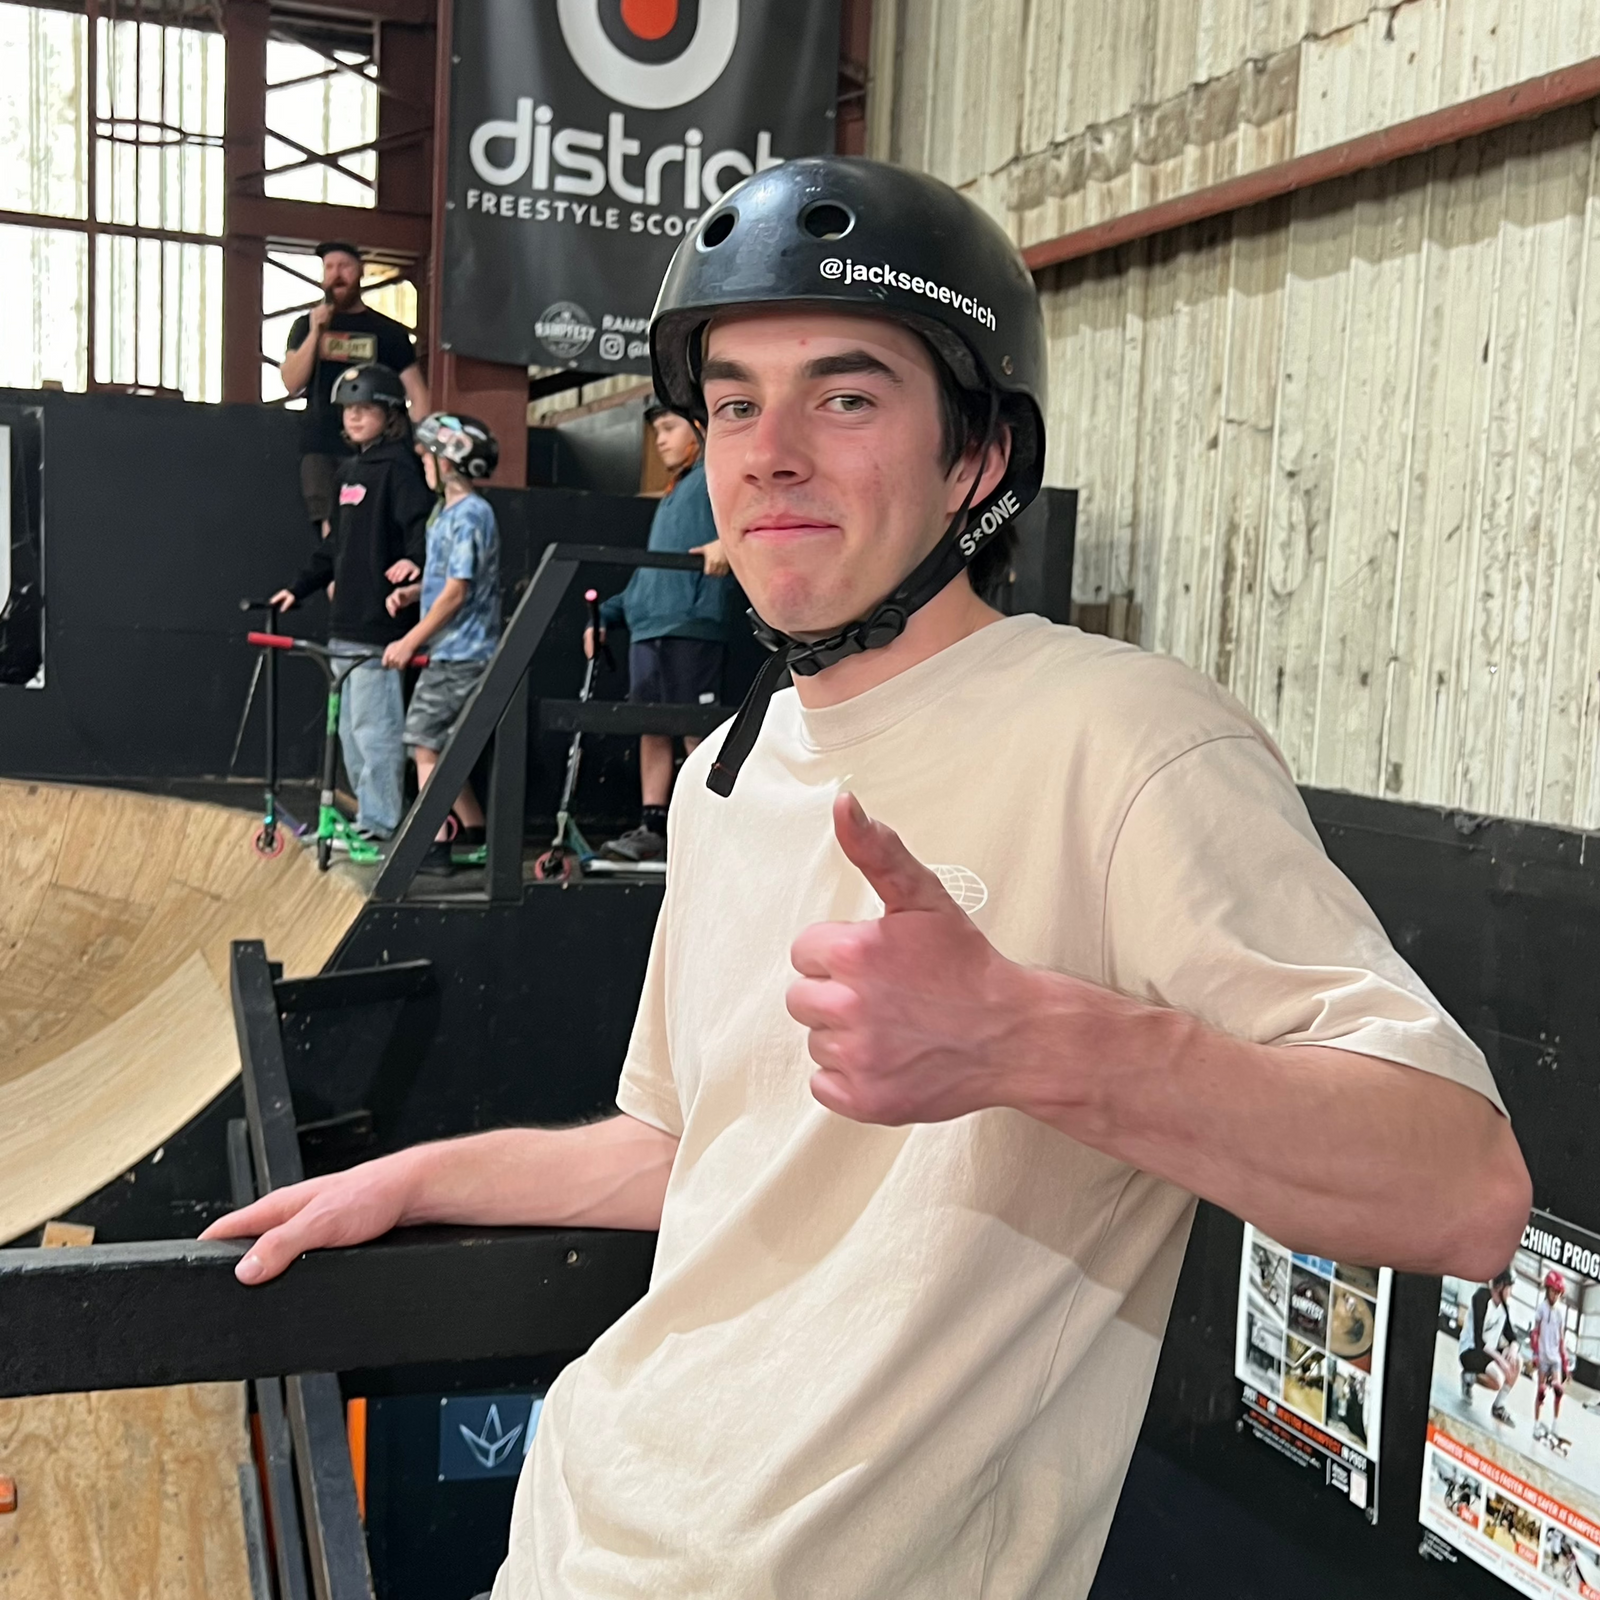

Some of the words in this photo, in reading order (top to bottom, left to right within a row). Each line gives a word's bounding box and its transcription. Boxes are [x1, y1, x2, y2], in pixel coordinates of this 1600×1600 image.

[466, 189, 620, 230] FREESTYLE
[1520, 1224, 1562, 1261] CHING
[1562, 1241, 1600, 1280] PROG
